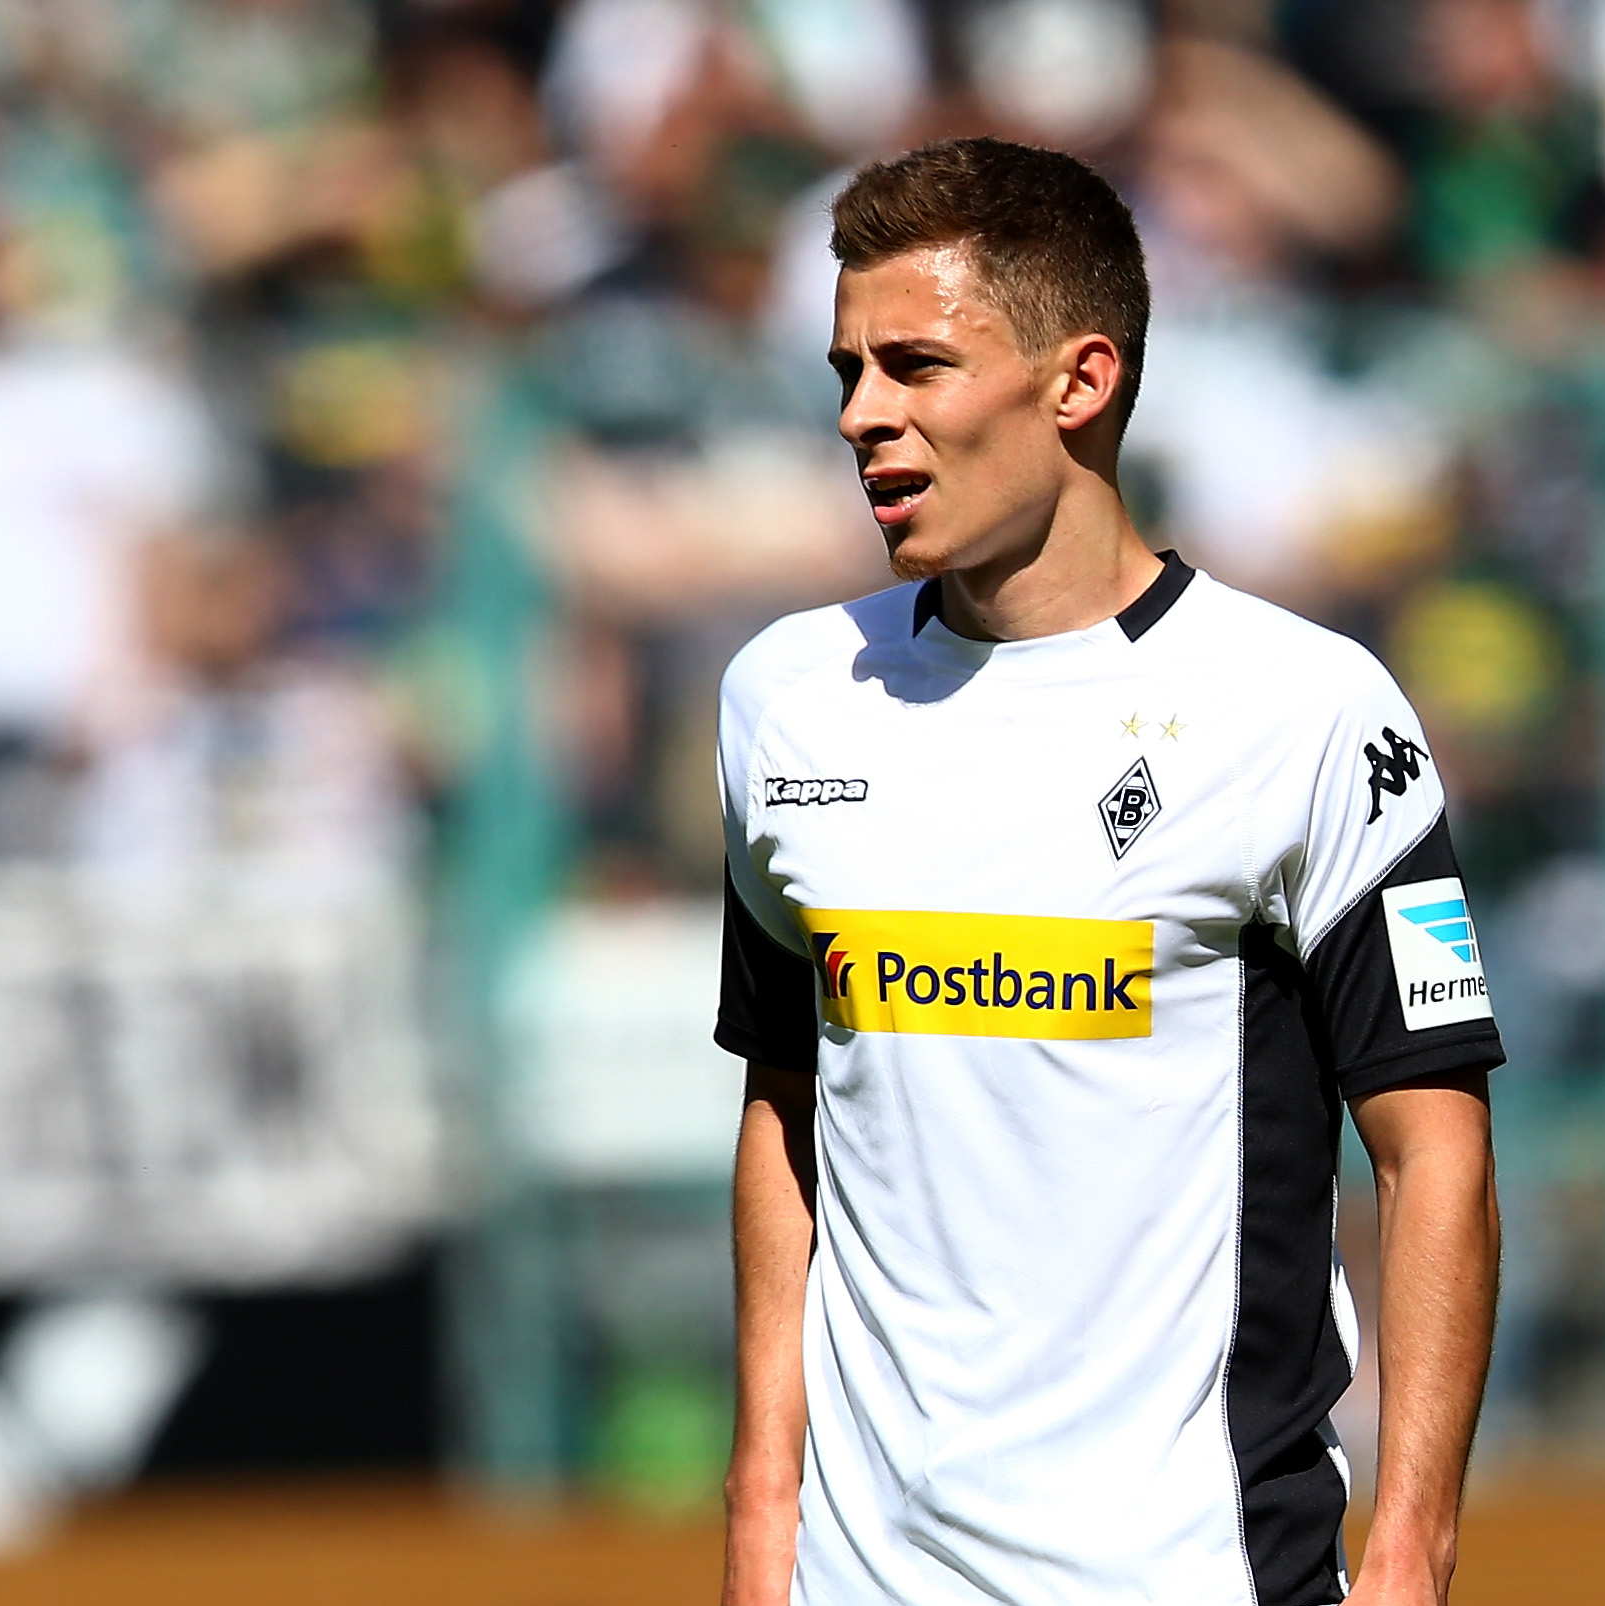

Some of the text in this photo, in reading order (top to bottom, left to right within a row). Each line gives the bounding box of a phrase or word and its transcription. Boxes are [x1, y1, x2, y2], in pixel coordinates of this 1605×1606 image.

[765, 777, 869, 807] Kappa
[877, 951, 1140, 1012] Postbank
[1408, 975, 1489, 1008] Herme
